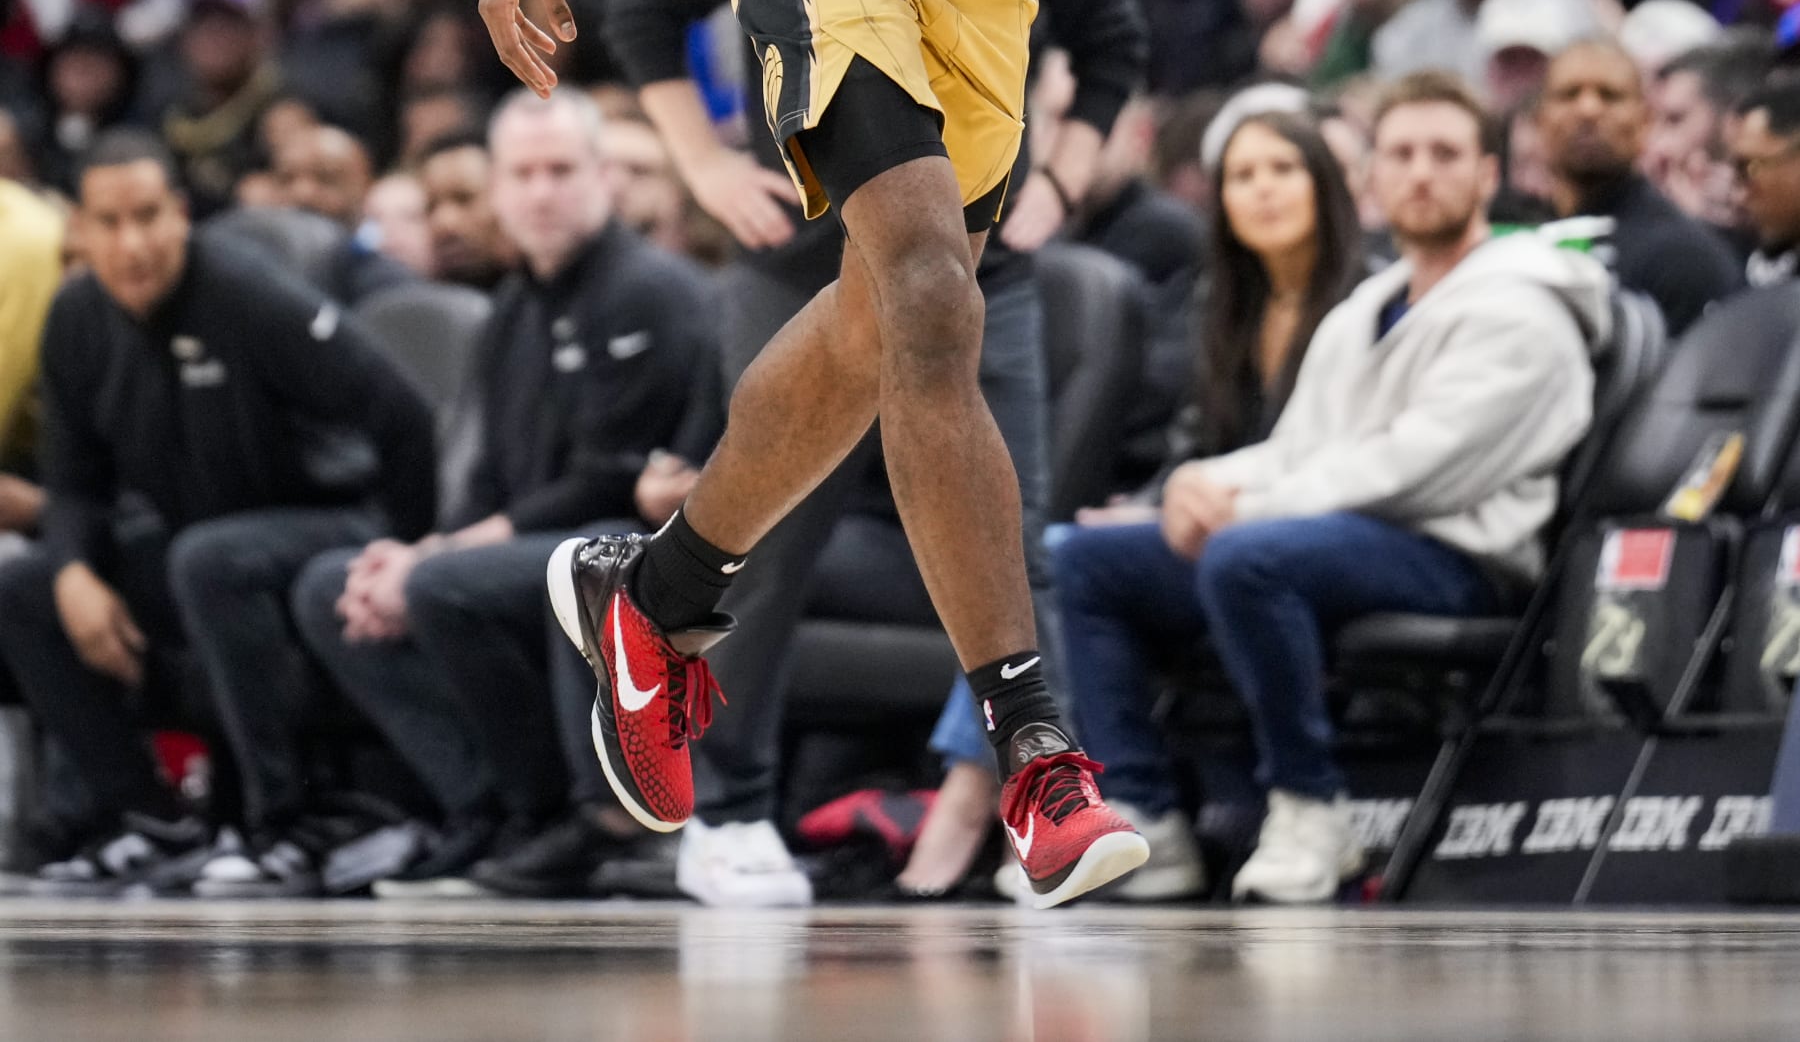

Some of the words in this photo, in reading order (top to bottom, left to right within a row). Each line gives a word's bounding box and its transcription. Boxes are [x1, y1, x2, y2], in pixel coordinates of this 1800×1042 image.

[1434, 802, 1527, 858] IBM
[1522, 796, 1614, 853] IBM
[1607, 794, 1703, 851] IBM
